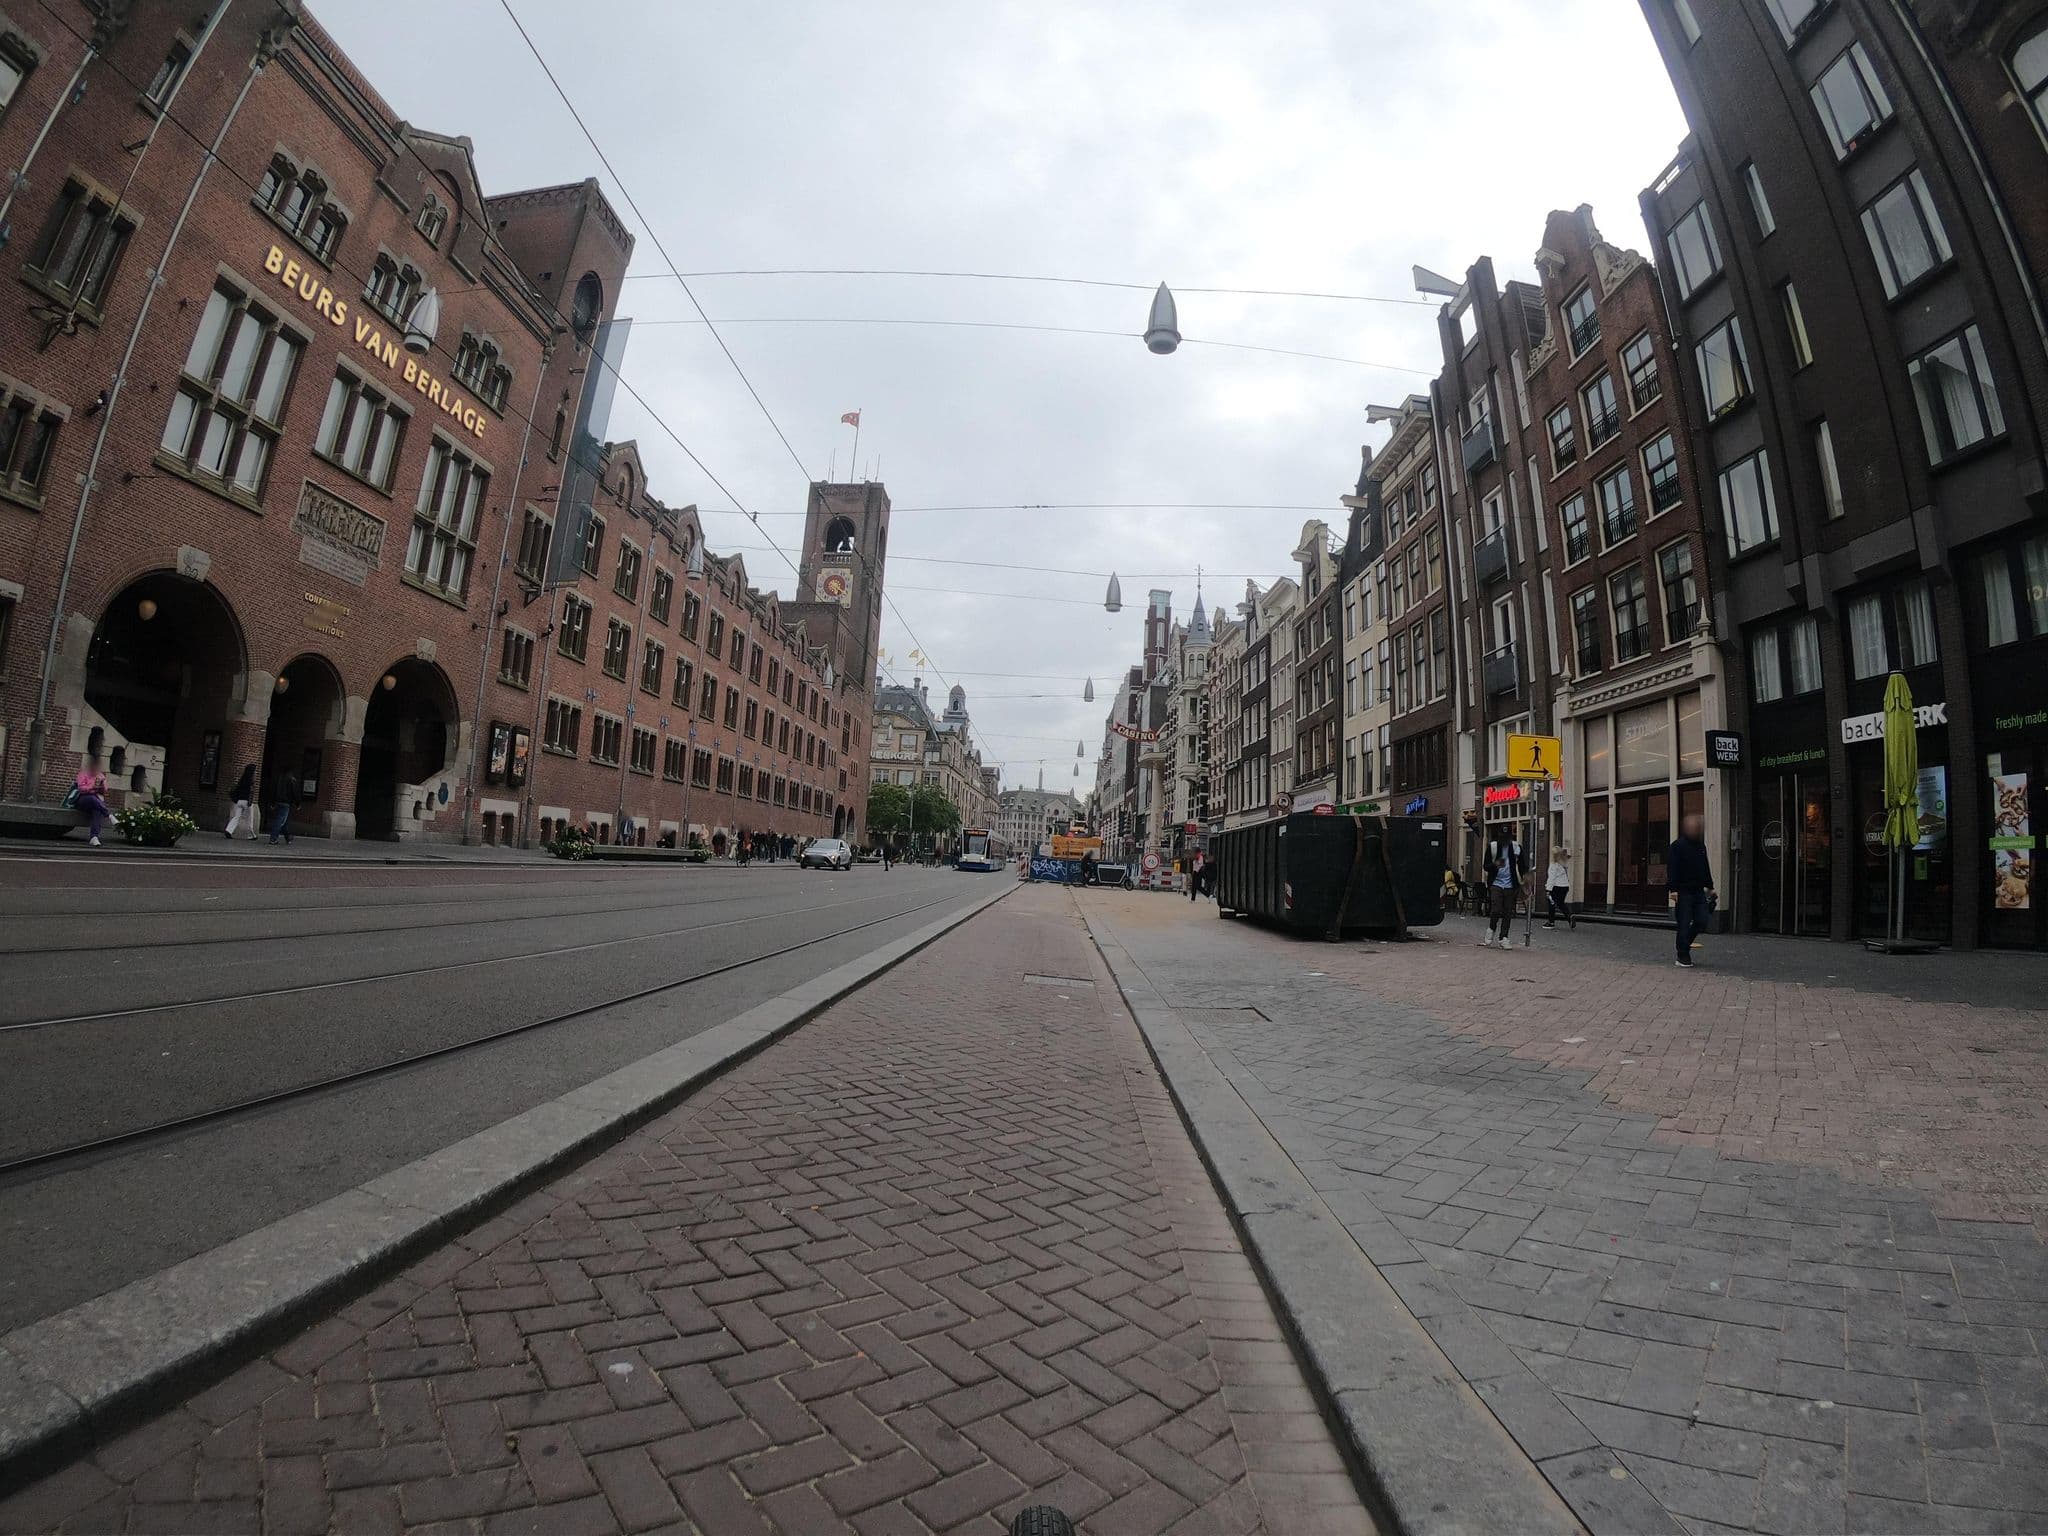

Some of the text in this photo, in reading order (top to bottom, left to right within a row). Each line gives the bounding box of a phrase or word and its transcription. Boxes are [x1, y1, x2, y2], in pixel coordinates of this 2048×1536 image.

[264, 245, 487, 439] BEURS VAN BERLAGE
[1844, 716, 1884, 740] back
[1995, 709, 2048, 730] Freshly made
[1117, 726, 1155, 741] CASINO
[1716, 738, 1738, 750] back
[1716, 751, 1740, 762] WERK
[1776, 751, 1803, 765] breakfast
[1809, 748, 1826, 760] lunch
